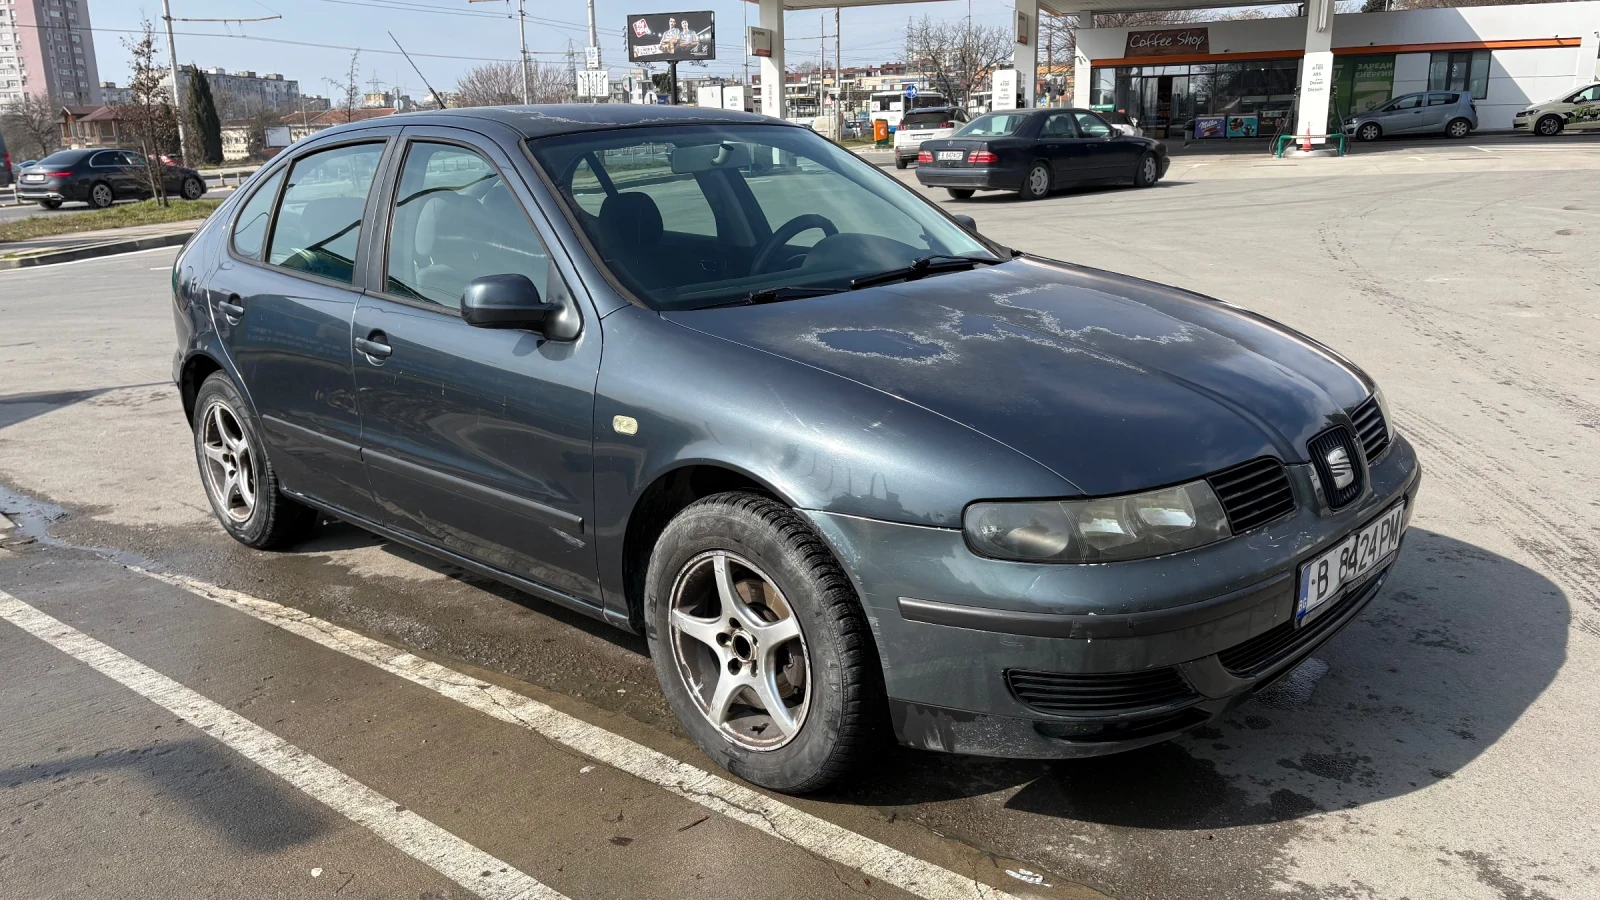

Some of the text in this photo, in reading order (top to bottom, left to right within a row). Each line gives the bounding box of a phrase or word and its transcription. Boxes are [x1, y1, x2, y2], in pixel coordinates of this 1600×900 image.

[1130, 32, 1204, 50] Coffee Shop
[1357, 62, 1393, 70] ЗАРЕДИ
[1355, 70, 1393, 78] ЕНЕРГИЯ
[1198, 119, 1218, 129] Milka
[1316, 559, 1328, 601] B
